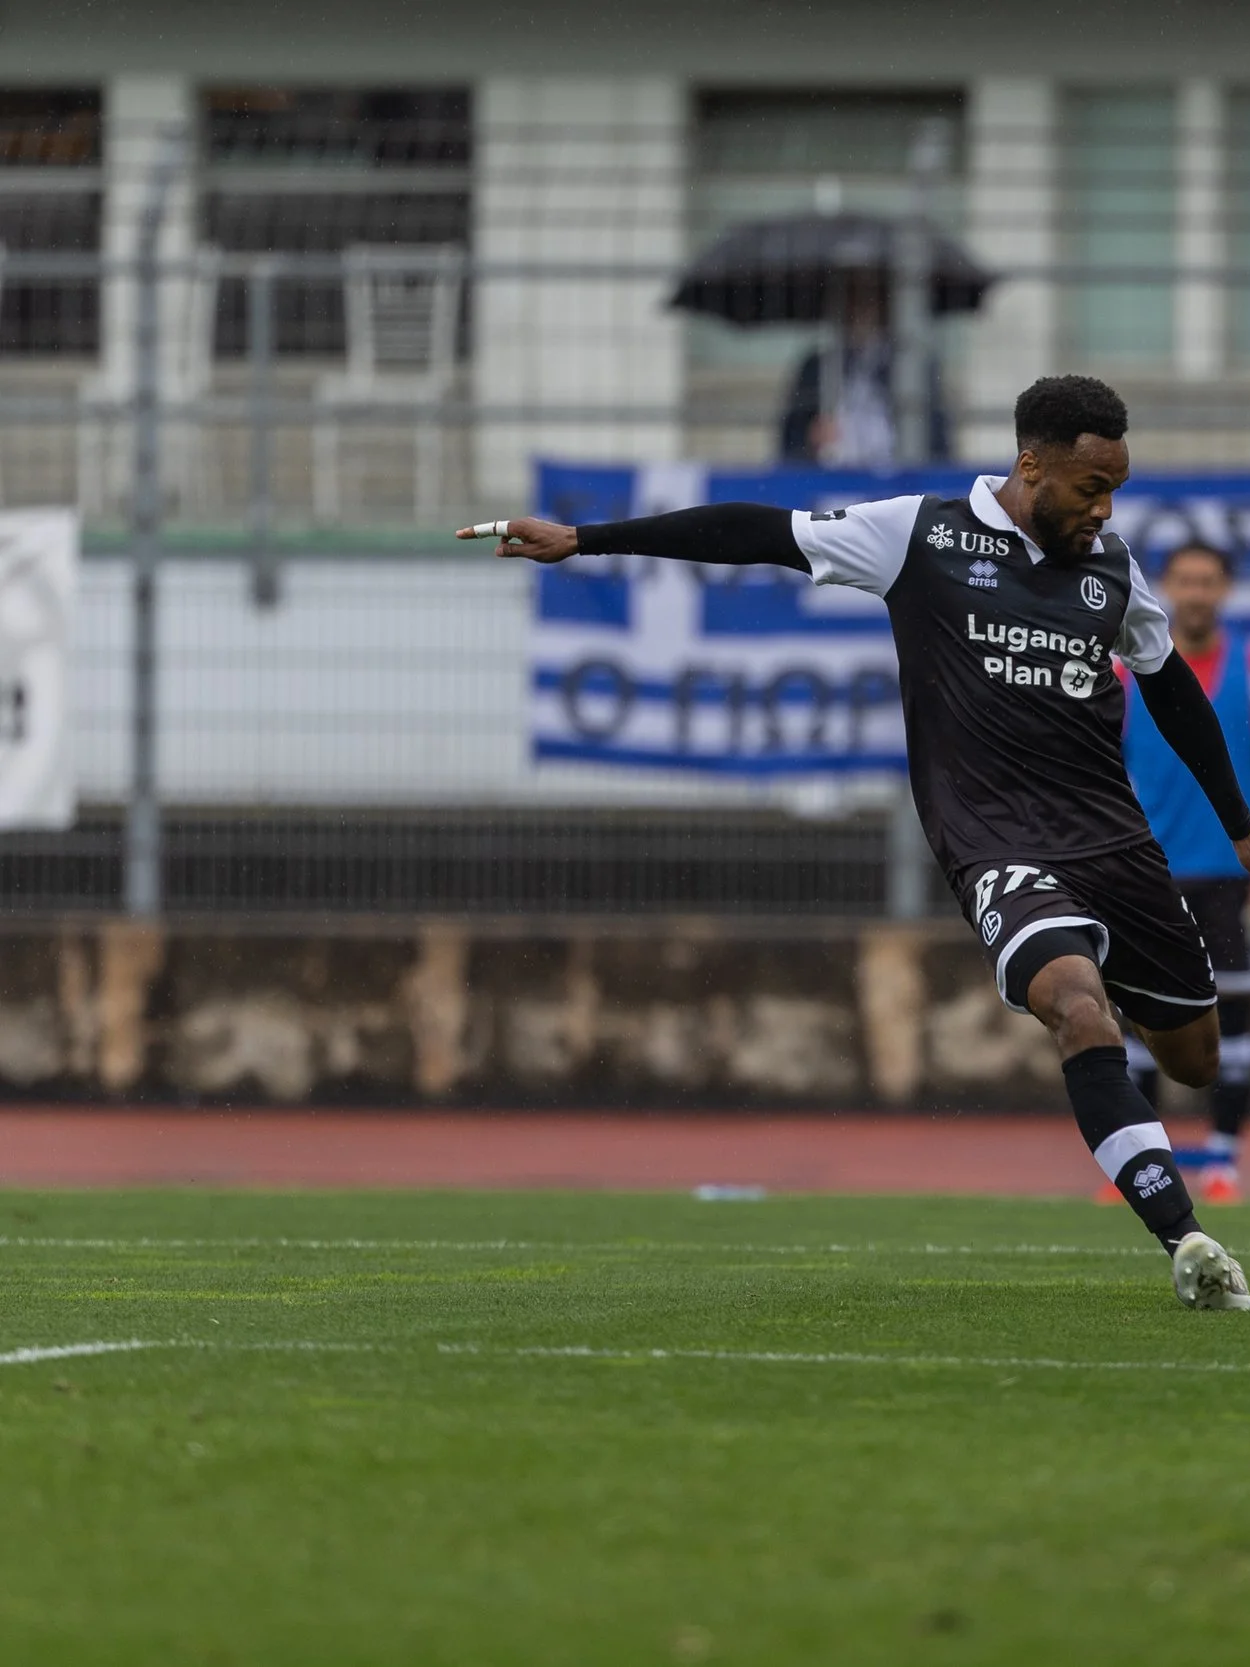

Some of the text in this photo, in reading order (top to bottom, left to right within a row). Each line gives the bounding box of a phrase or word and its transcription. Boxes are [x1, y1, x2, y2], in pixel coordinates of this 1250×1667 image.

[960, 532, 1010, 556] UBS
[967, 614, 1103, 661] Lugano's
[984, 656, 1052, 687] Plan
